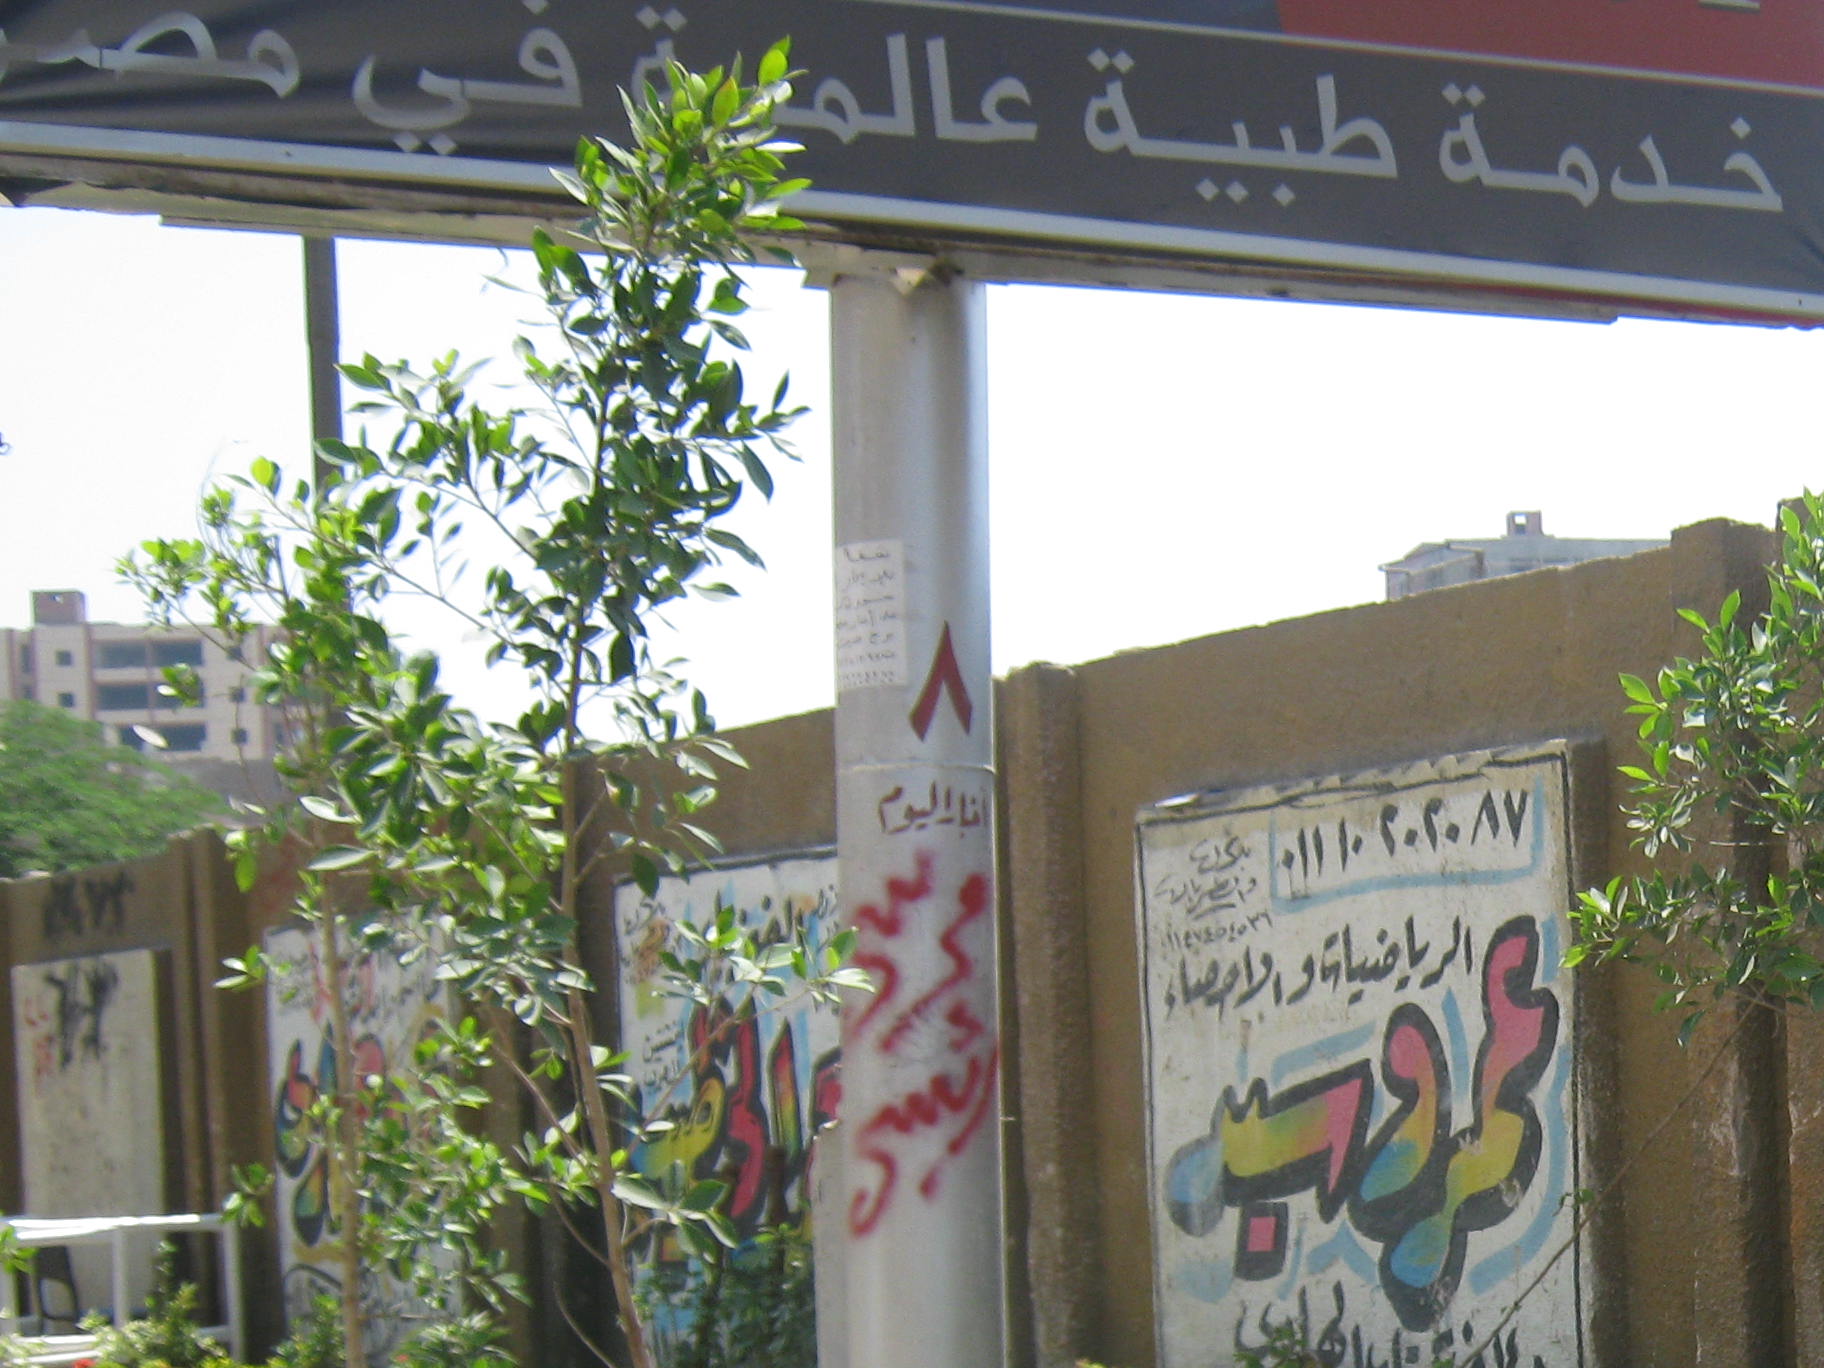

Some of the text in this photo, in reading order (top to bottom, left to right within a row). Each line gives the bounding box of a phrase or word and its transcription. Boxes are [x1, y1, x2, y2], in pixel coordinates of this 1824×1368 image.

[0, 10, 300, 99] مص
[630, 6, 1038, 145] عالمة
[1082, 47, 1399, 207] طبية
[1438, 82, 1785, 213] خدمة
[1318, 913, 1474, 1006] الرياضيات
